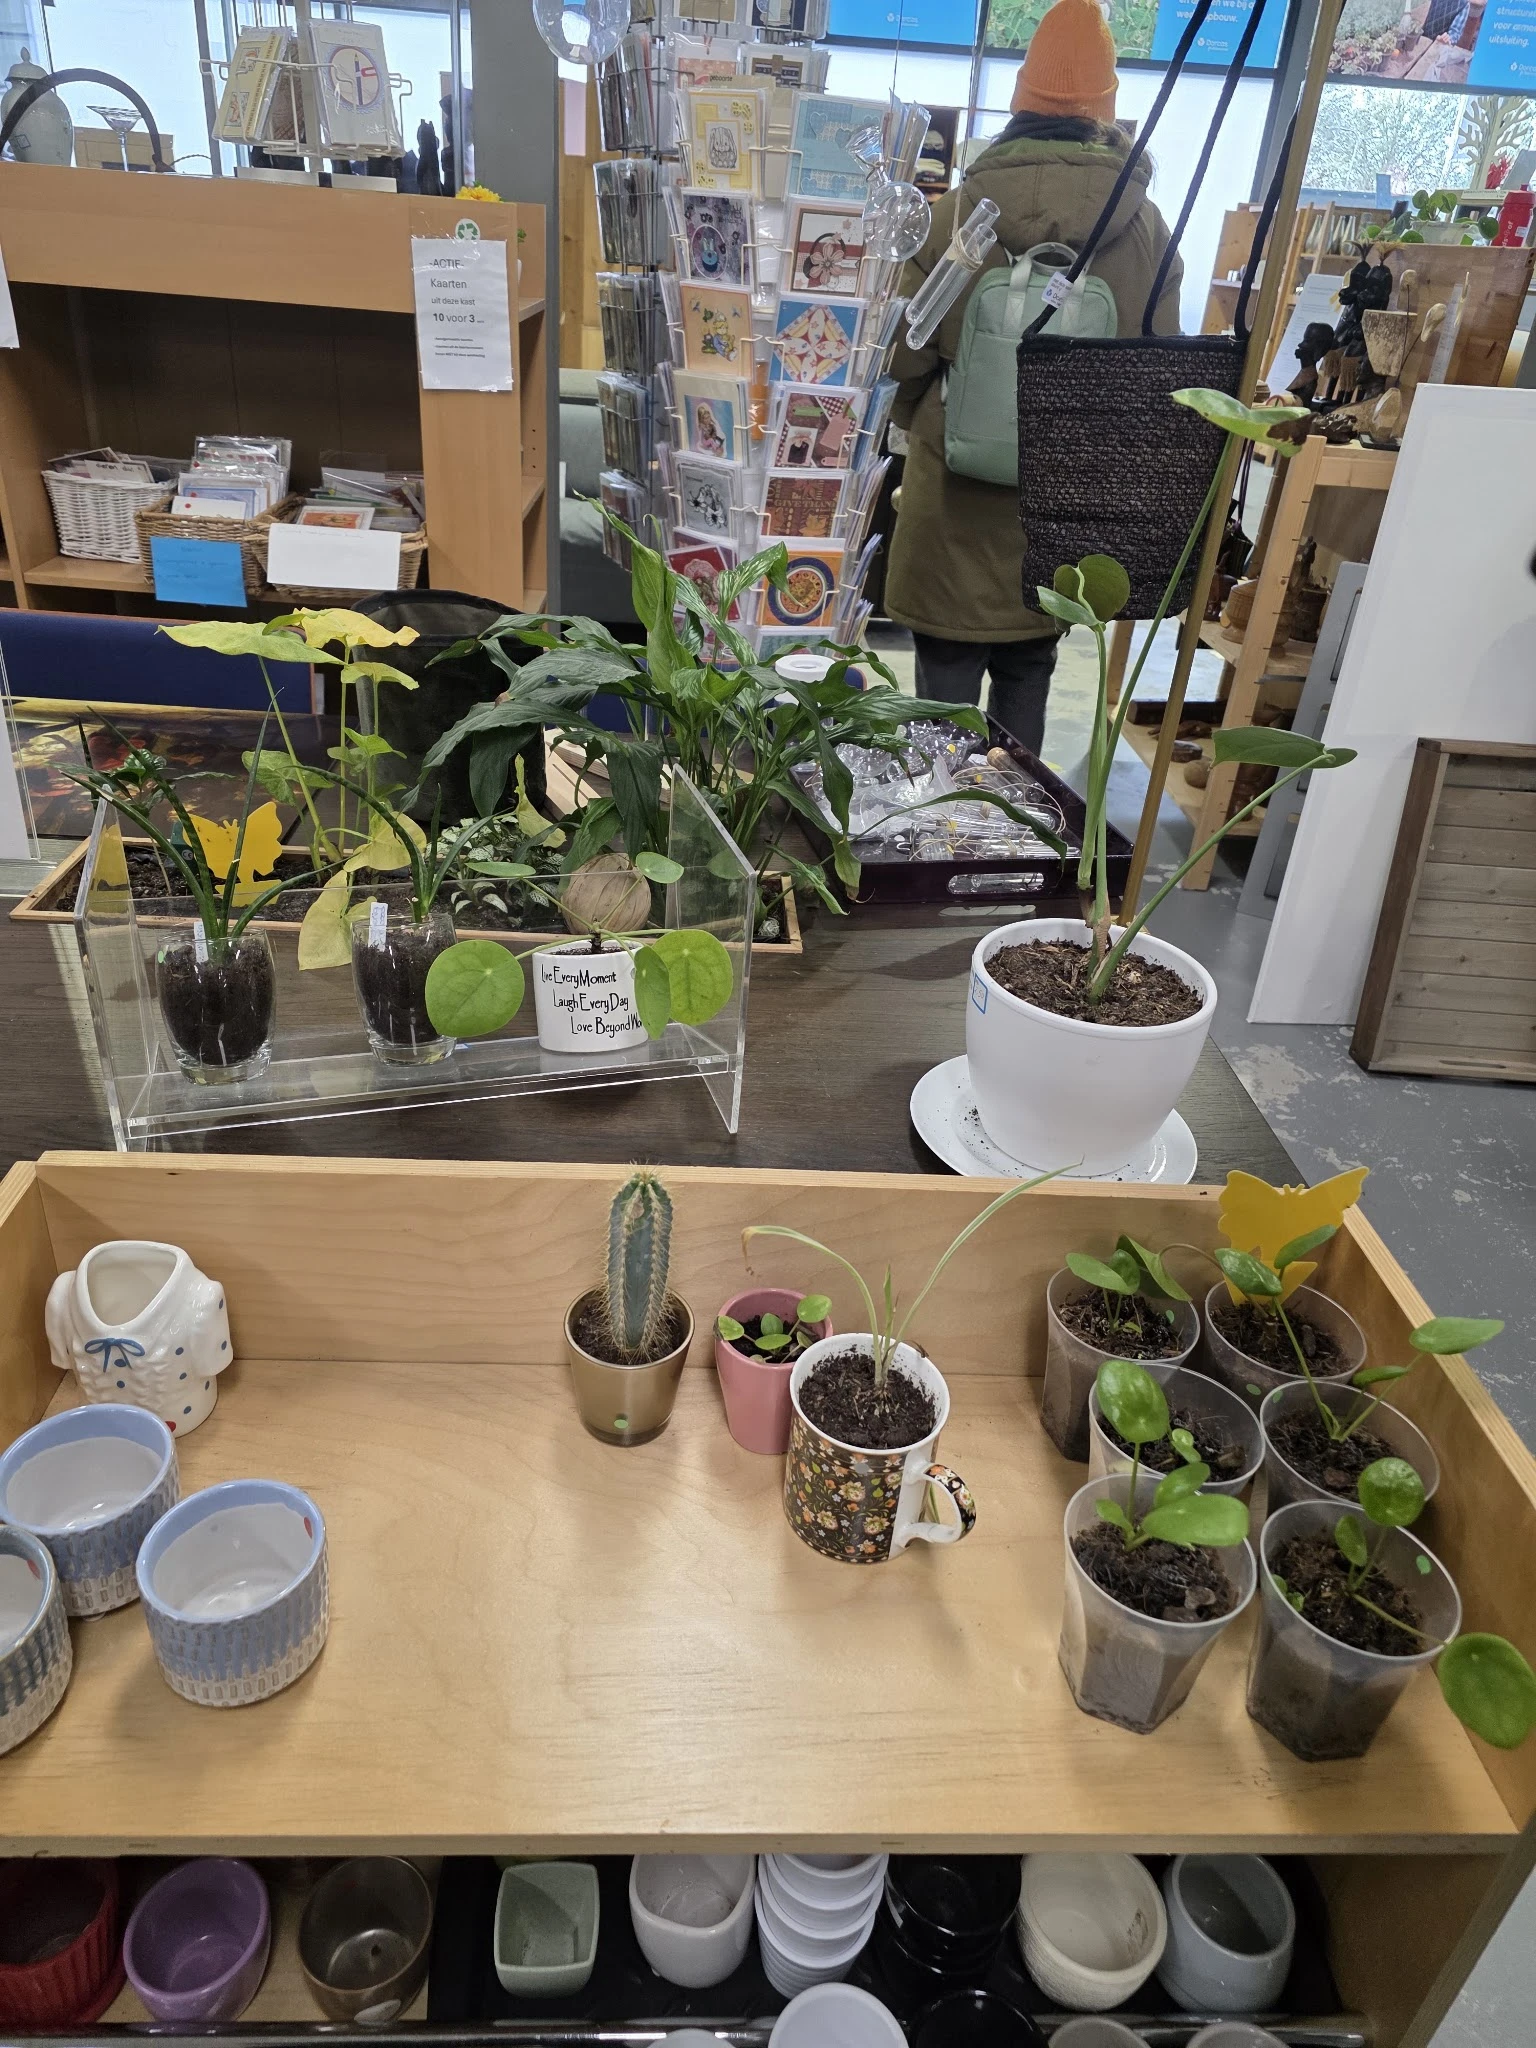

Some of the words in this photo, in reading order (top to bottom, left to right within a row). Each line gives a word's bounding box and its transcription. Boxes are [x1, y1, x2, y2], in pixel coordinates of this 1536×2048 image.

[1493, 22, 1511, 30] voor
[1206, 39, 1228, 48] Dorcas
[1489, 34, 1529, 48] uitsluiting.
[430, 278, 467, 289] Kaarten
[442, 297, 459, 305] deze
[460, 298, 476, 306] kast
[433, 313, 445, 322] 10
[446, 315, 467, 323] voor
[469, 314, 476, 323] 3
[541, 963, 552, 983] Live
[553, 966, 579, 989] Every
[579, 969, 617, 987] Moment
[553, 988, 579, 1012] Laugh
[579, 993, 609, 1014] Every
[609, 992, 629, 1011] Day
[570, 1015, 593, 1035] Love
[595, 1013, 630, 1038] Beyond
